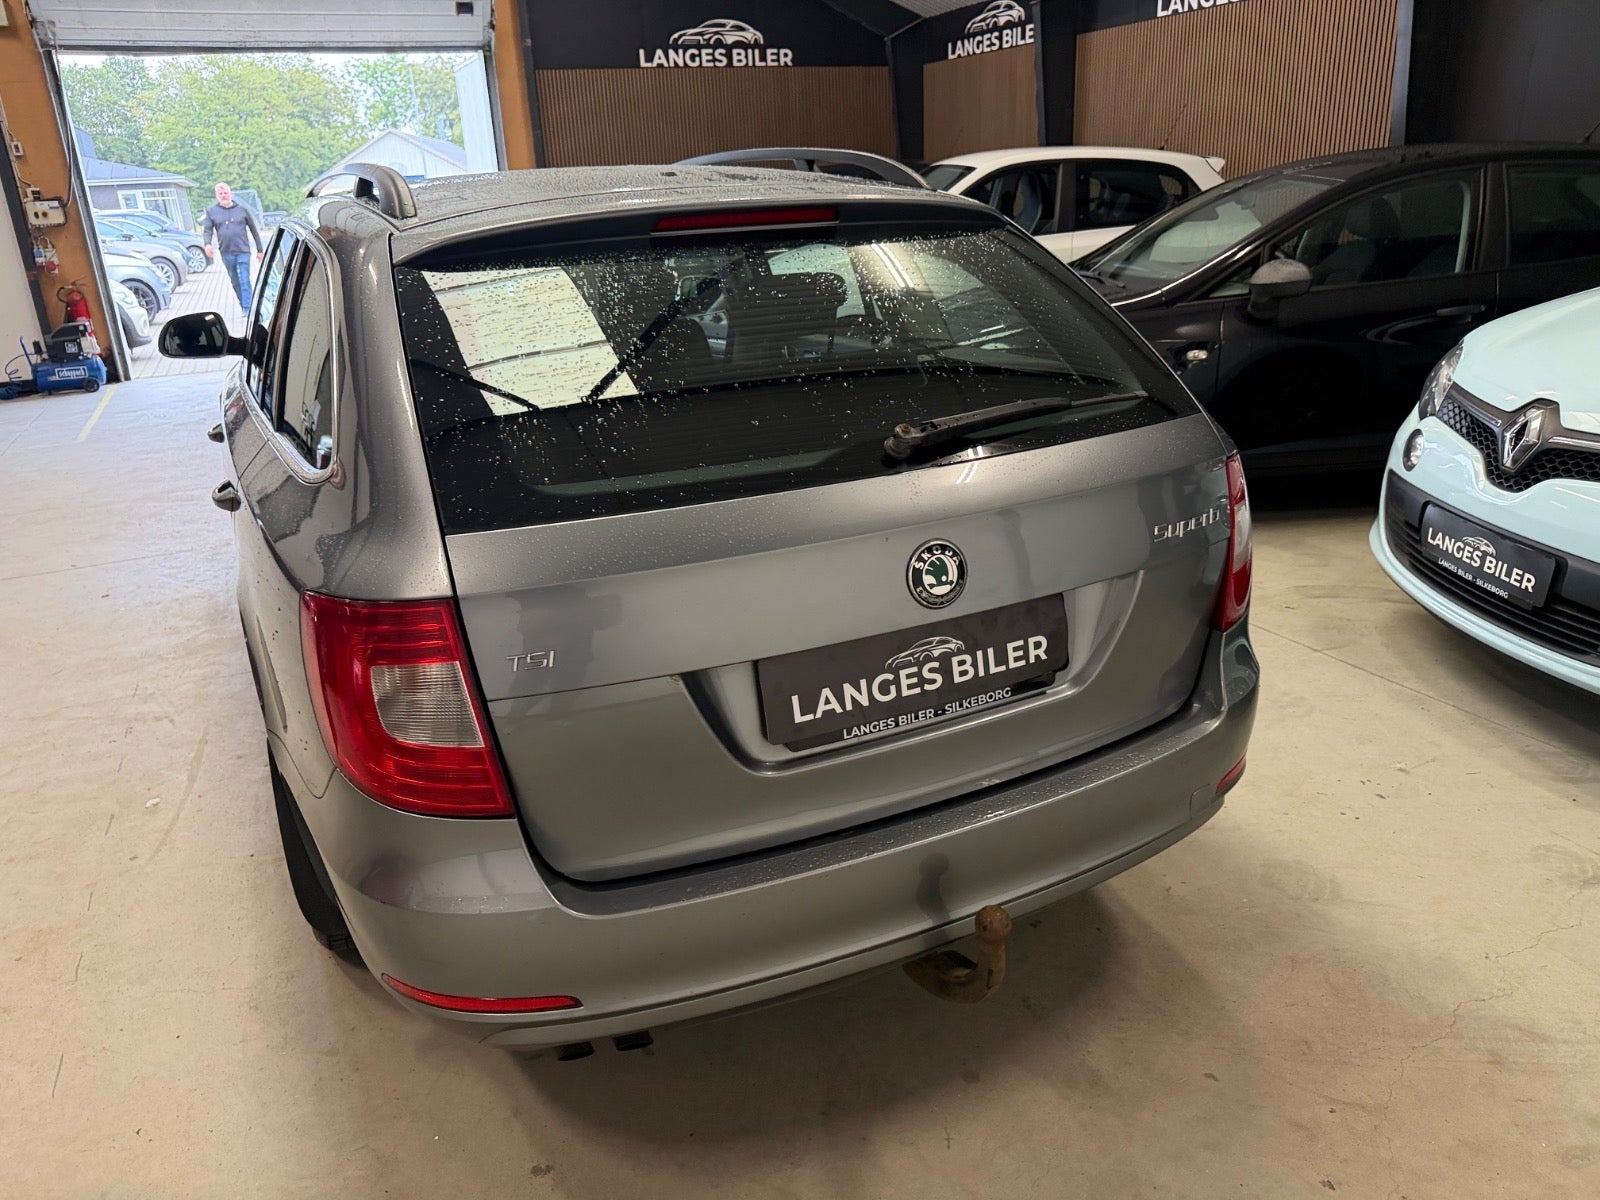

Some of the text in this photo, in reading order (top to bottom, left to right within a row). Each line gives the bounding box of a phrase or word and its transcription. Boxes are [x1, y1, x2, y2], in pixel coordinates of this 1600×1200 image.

[638, 48, 793, 68] LANGES BILER
[947, 31, 1000, 60] LANGES
[1153, 508, 1220, 542] Superb
[1427, 527, 1536, 593] LANGES BILER
[1438, 557, 1458, 573] LANGES
[1457, 568, 1473, 582] BILER
[1476, 578, 1509, 599] SILKEBORG
[506, 650, 555, 672] TSI
[791, 635, 1048, 724] LANGES BILER
[843, 717, 896, 740] LANGES
[898, 708, 935, 726] BILER
[945, 687, 1012, 714] SILKEBORG
